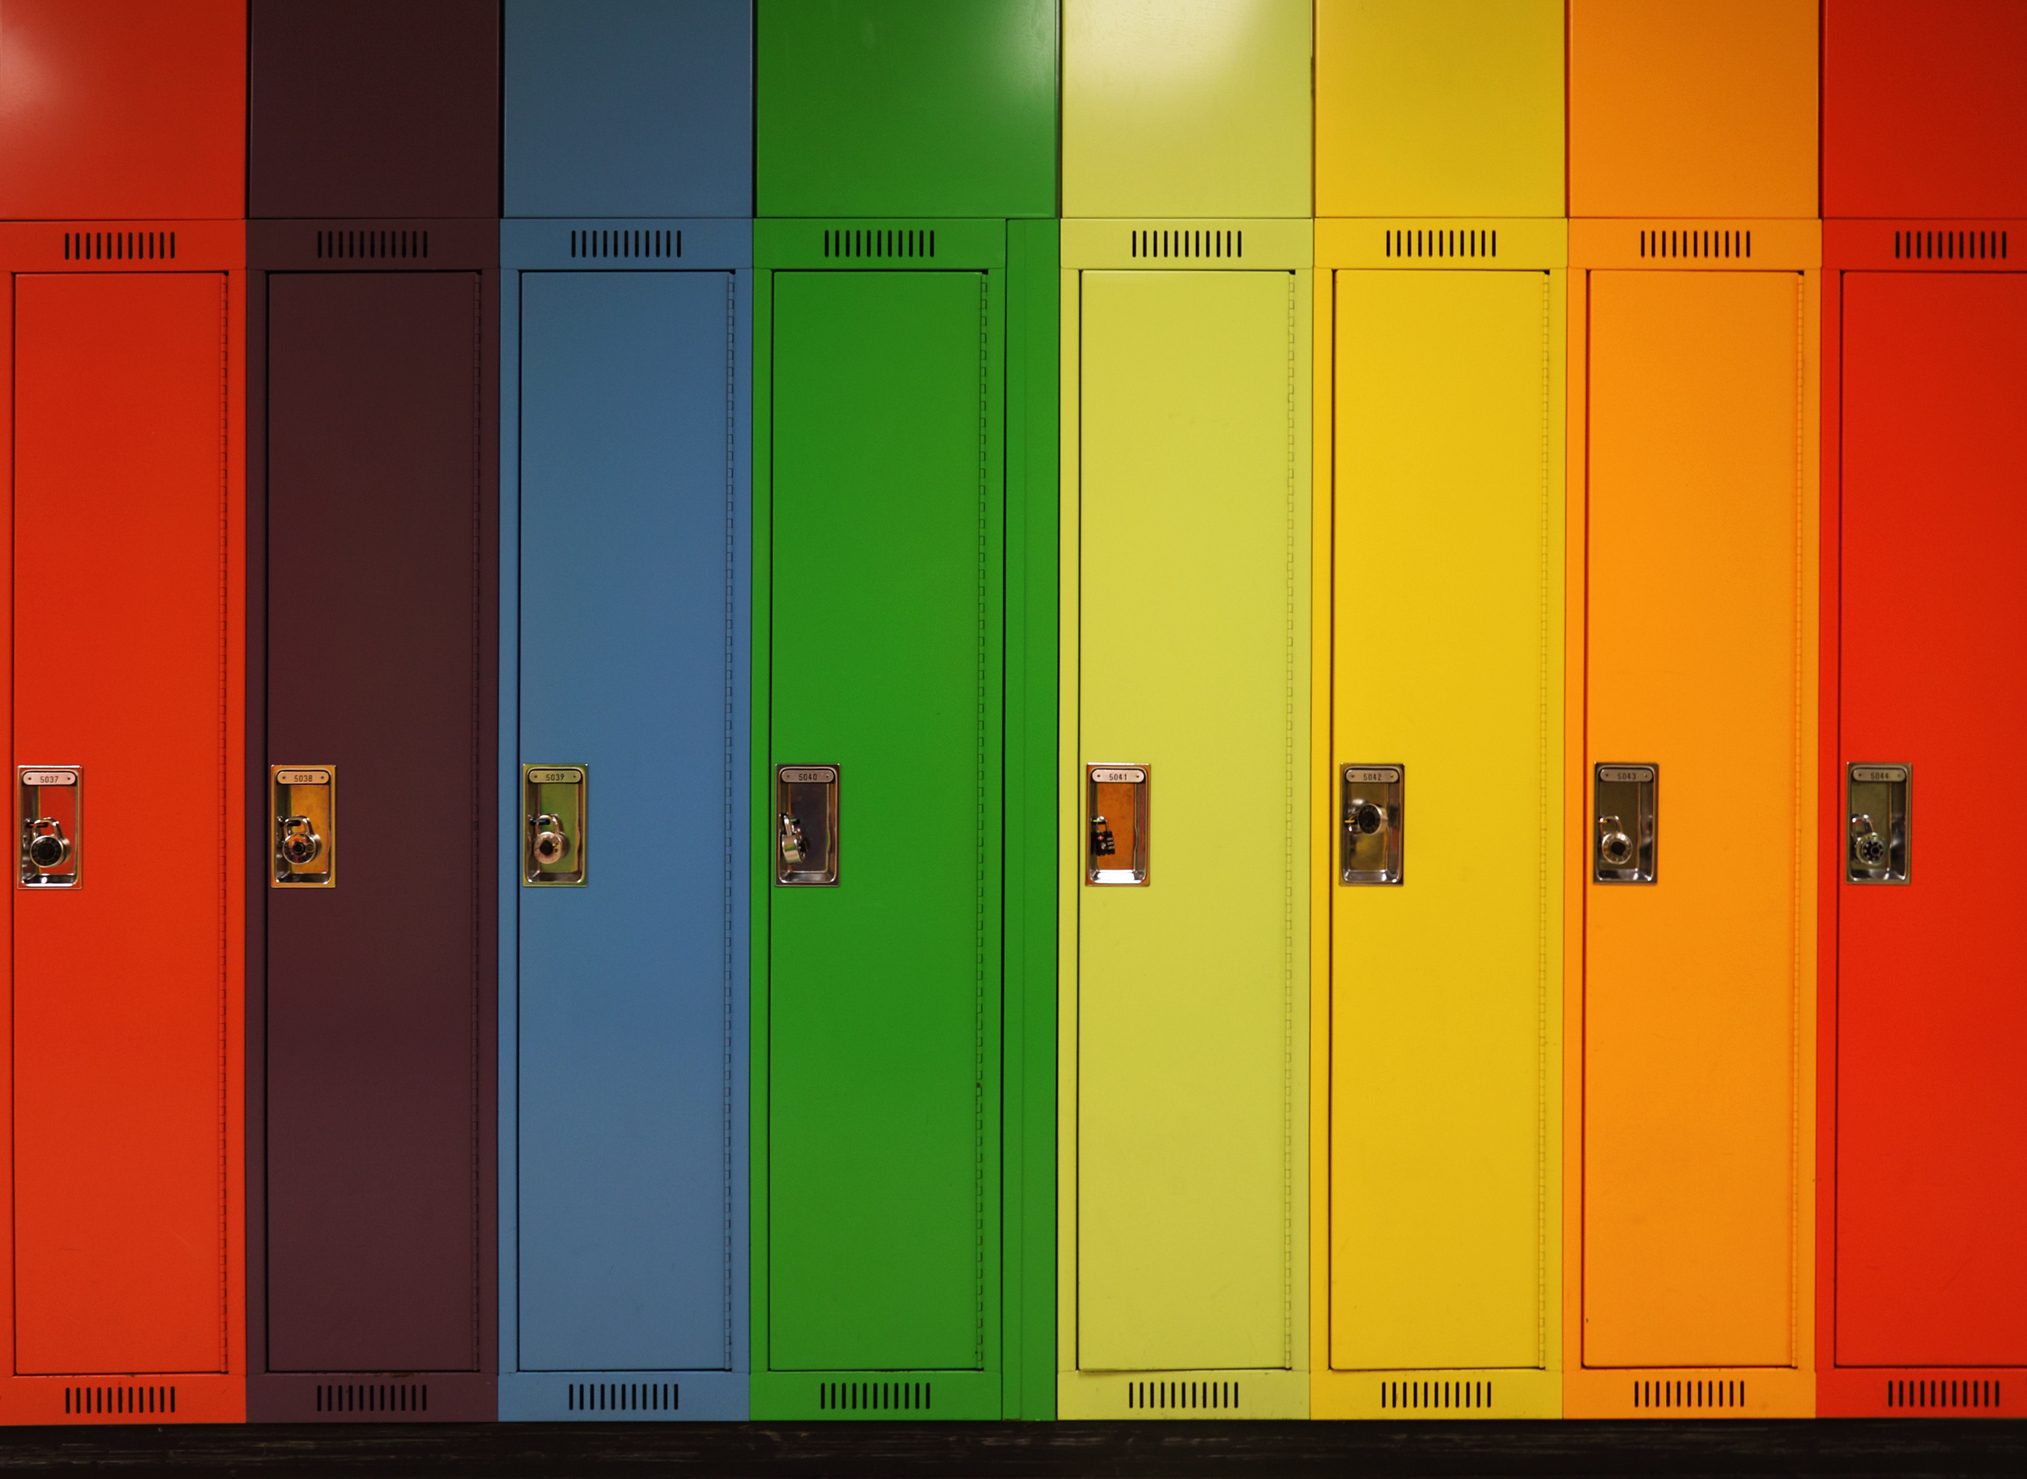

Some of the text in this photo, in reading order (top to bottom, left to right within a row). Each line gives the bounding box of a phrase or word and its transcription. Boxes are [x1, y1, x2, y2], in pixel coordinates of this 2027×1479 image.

[40, 775, 59, 784] 5037
[294, 774, 313, 783] 5038
[545, 773, 565, 782] 5039
[798, 773, 818, 782] 5040
[1109, 773, 1128, 781] 5041
